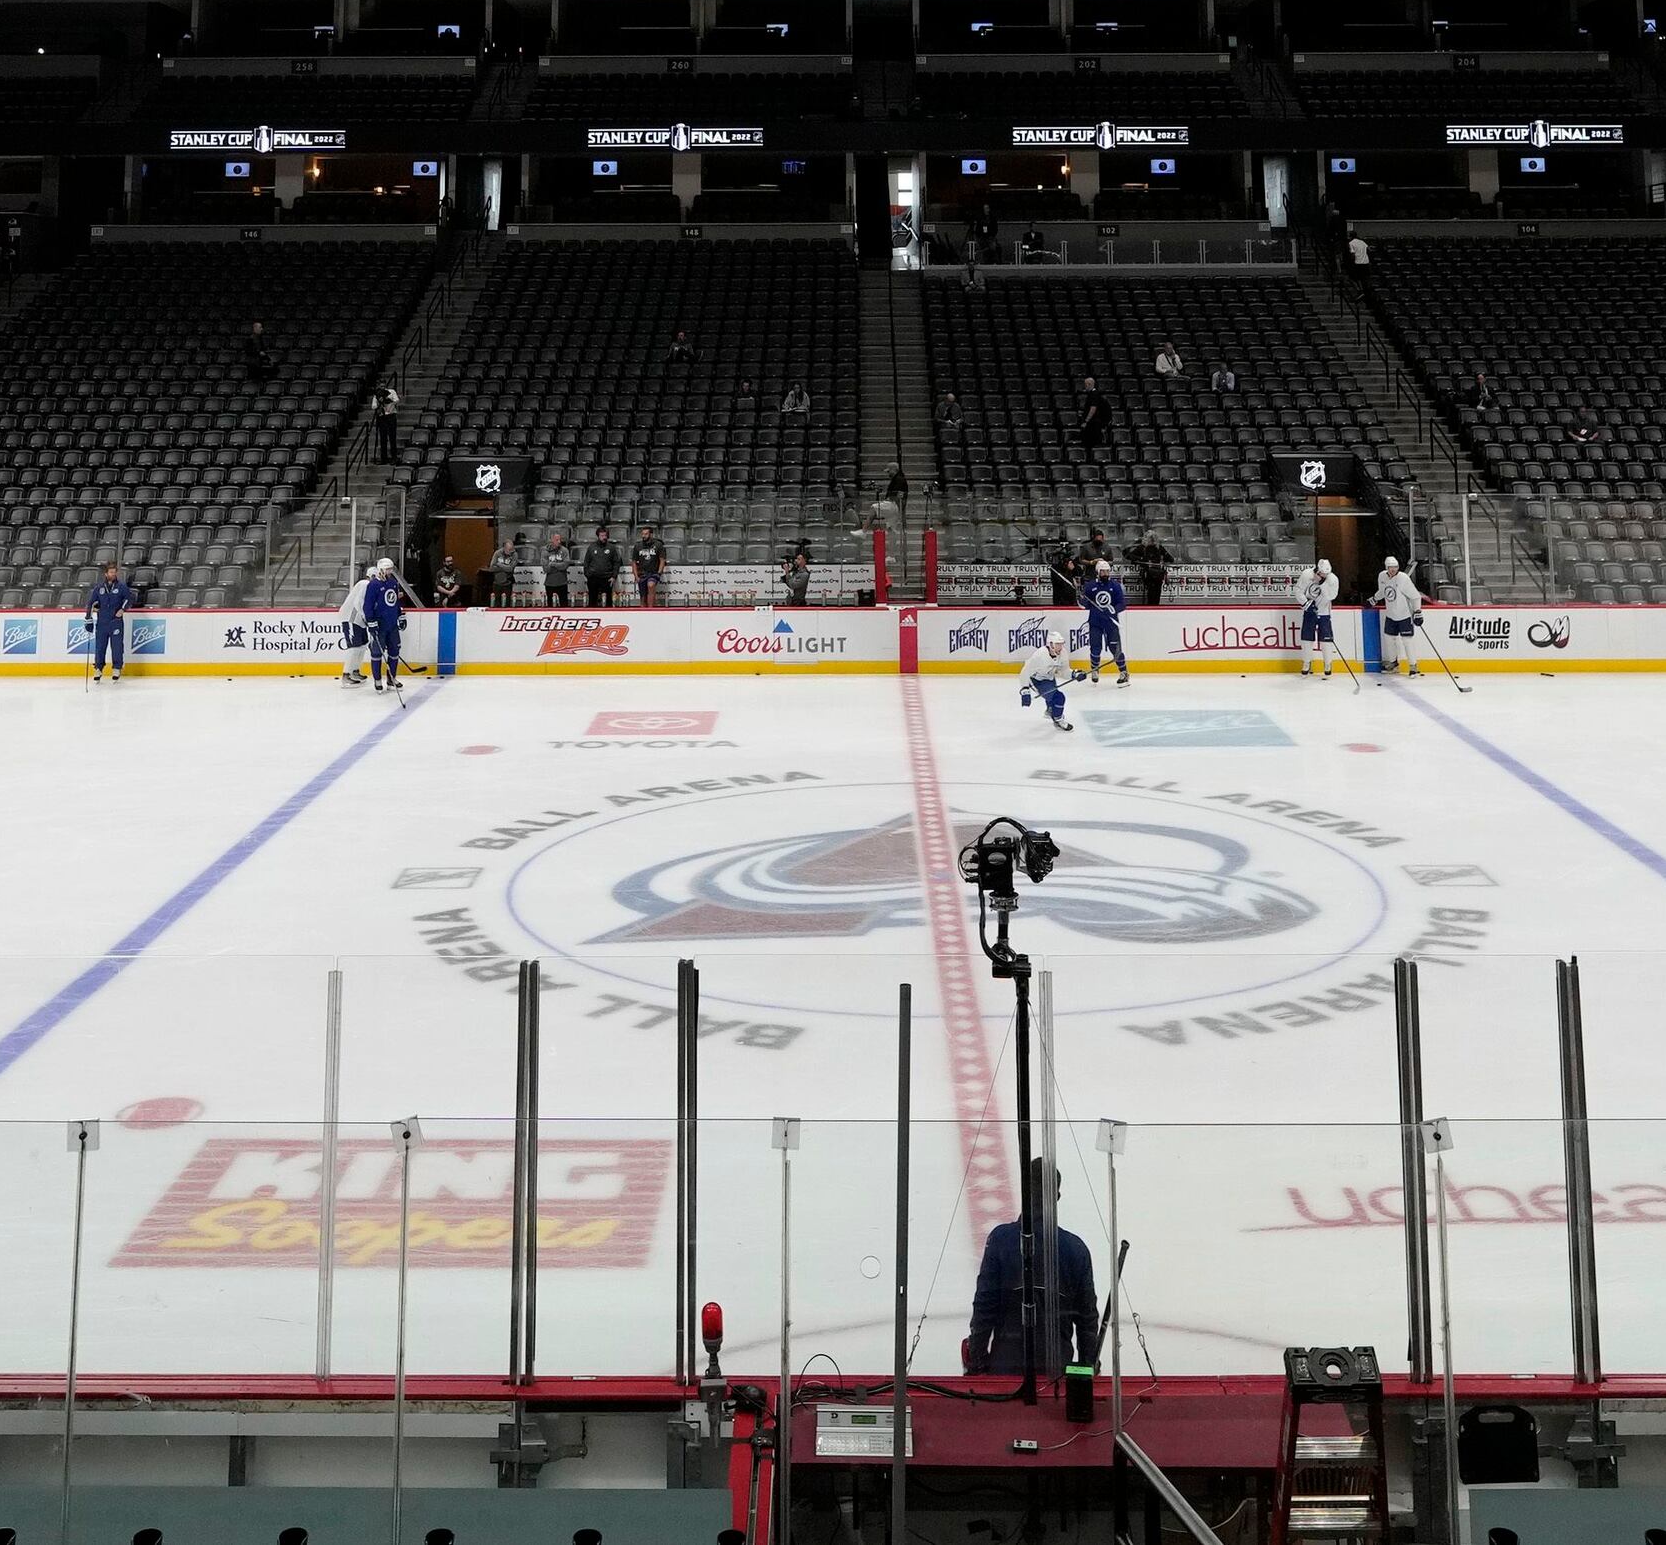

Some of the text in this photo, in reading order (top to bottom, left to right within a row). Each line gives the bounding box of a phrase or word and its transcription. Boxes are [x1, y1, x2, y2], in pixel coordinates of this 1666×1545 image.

[295, 62, 314, 71] 258
[671, 61, 689, 70] 260
[170, 134, 226, 146] STANLEY
[228, 134, 252, 146] CUP
[273, 133, 313, 145] FINAL
[587, 132, 643, 144] STANLEY
[645, 132, 669, 143] CUP
[692, 132, 730, 143] FINAL
[1013, 130, 1069, 142] STANLEY
[1070, 130, 1094, 141] CUP
[1116, 130, 1156, 141] FINAL
[1446, 129, 1502, 140] STANLEY
[1504, 129, 1528, 140] CUP
[1552, 129, 1590, 140] FINAL
[5, 620, 38, 643] Ball
[133, 621, 166, 643] Ball
[253, 621, 295, 636] Rocky
[500, 616, 600, 632] brothers
[1449, 616, 1510, 638] Altitude
[253, 637, 311, 653] Hospital
[316, 637, 334, 653] for
[536, 624, 630, 656] BBQ
[717, 628, 847, 654] Coors LIGHT
[949, 629, 989, 653] ENERGY
[1477, 638, 1510, 651] sports
[546, 740, 739, 749] TOYOTA
[459, 770, 824, 851] BALL ARENA
[1028, 769, 1406, 849] BALL ARENA
[207, 1152, 630, 1201] KING
